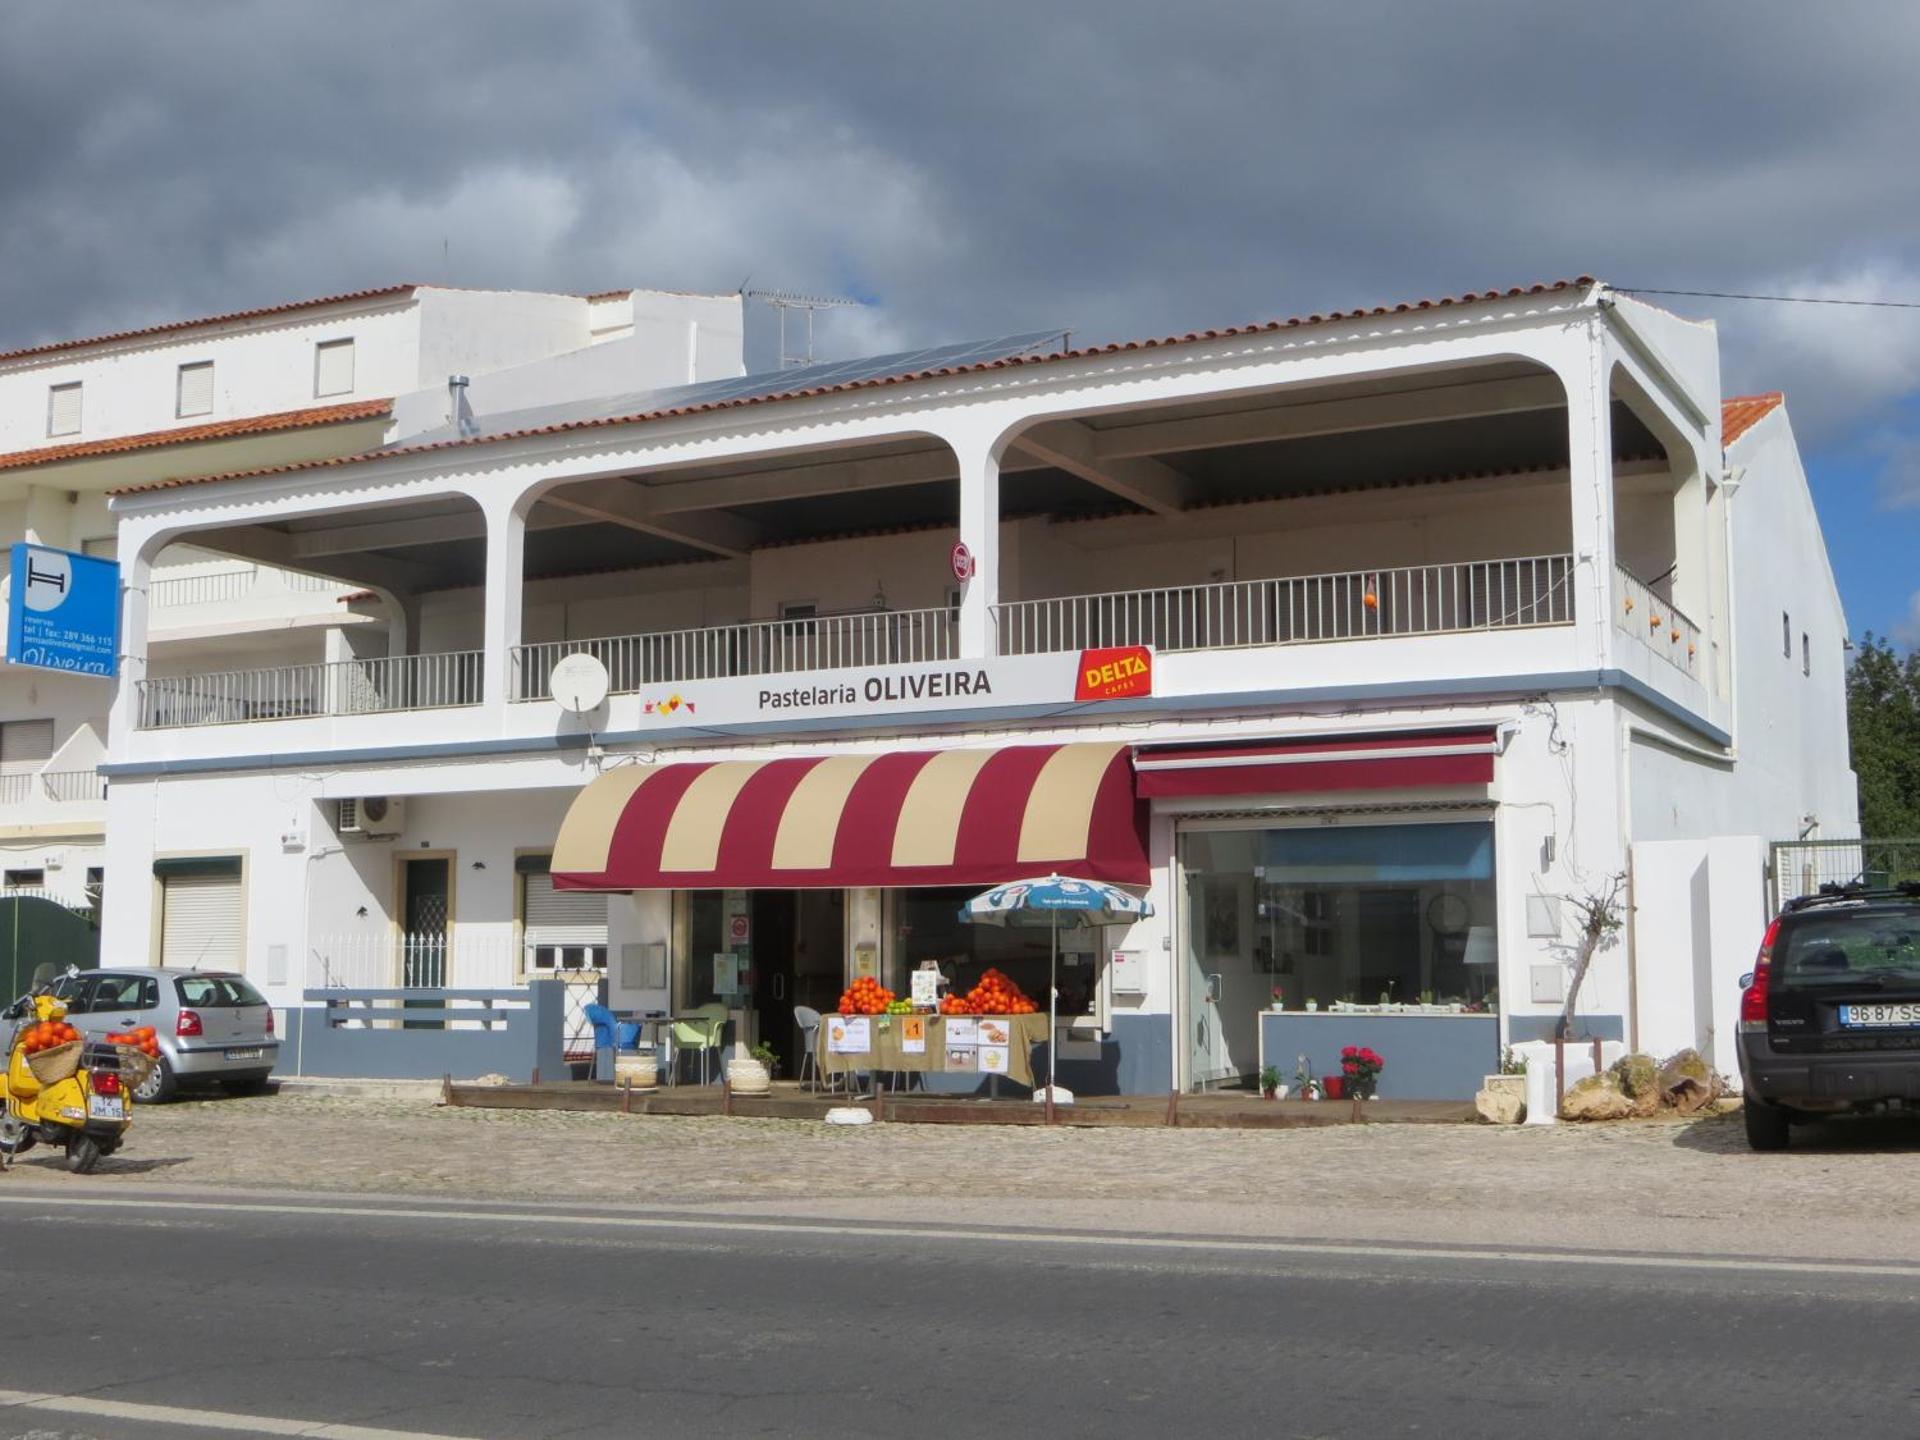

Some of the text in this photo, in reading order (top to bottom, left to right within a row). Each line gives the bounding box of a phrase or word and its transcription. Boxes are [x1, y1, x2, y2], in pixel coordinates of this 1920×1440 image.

[64, 630, 79, 640] 289
[1086, 656, 1148, 688] DELTA
[759, 670, 992, 709] Pastelaria OLIVEIRA
